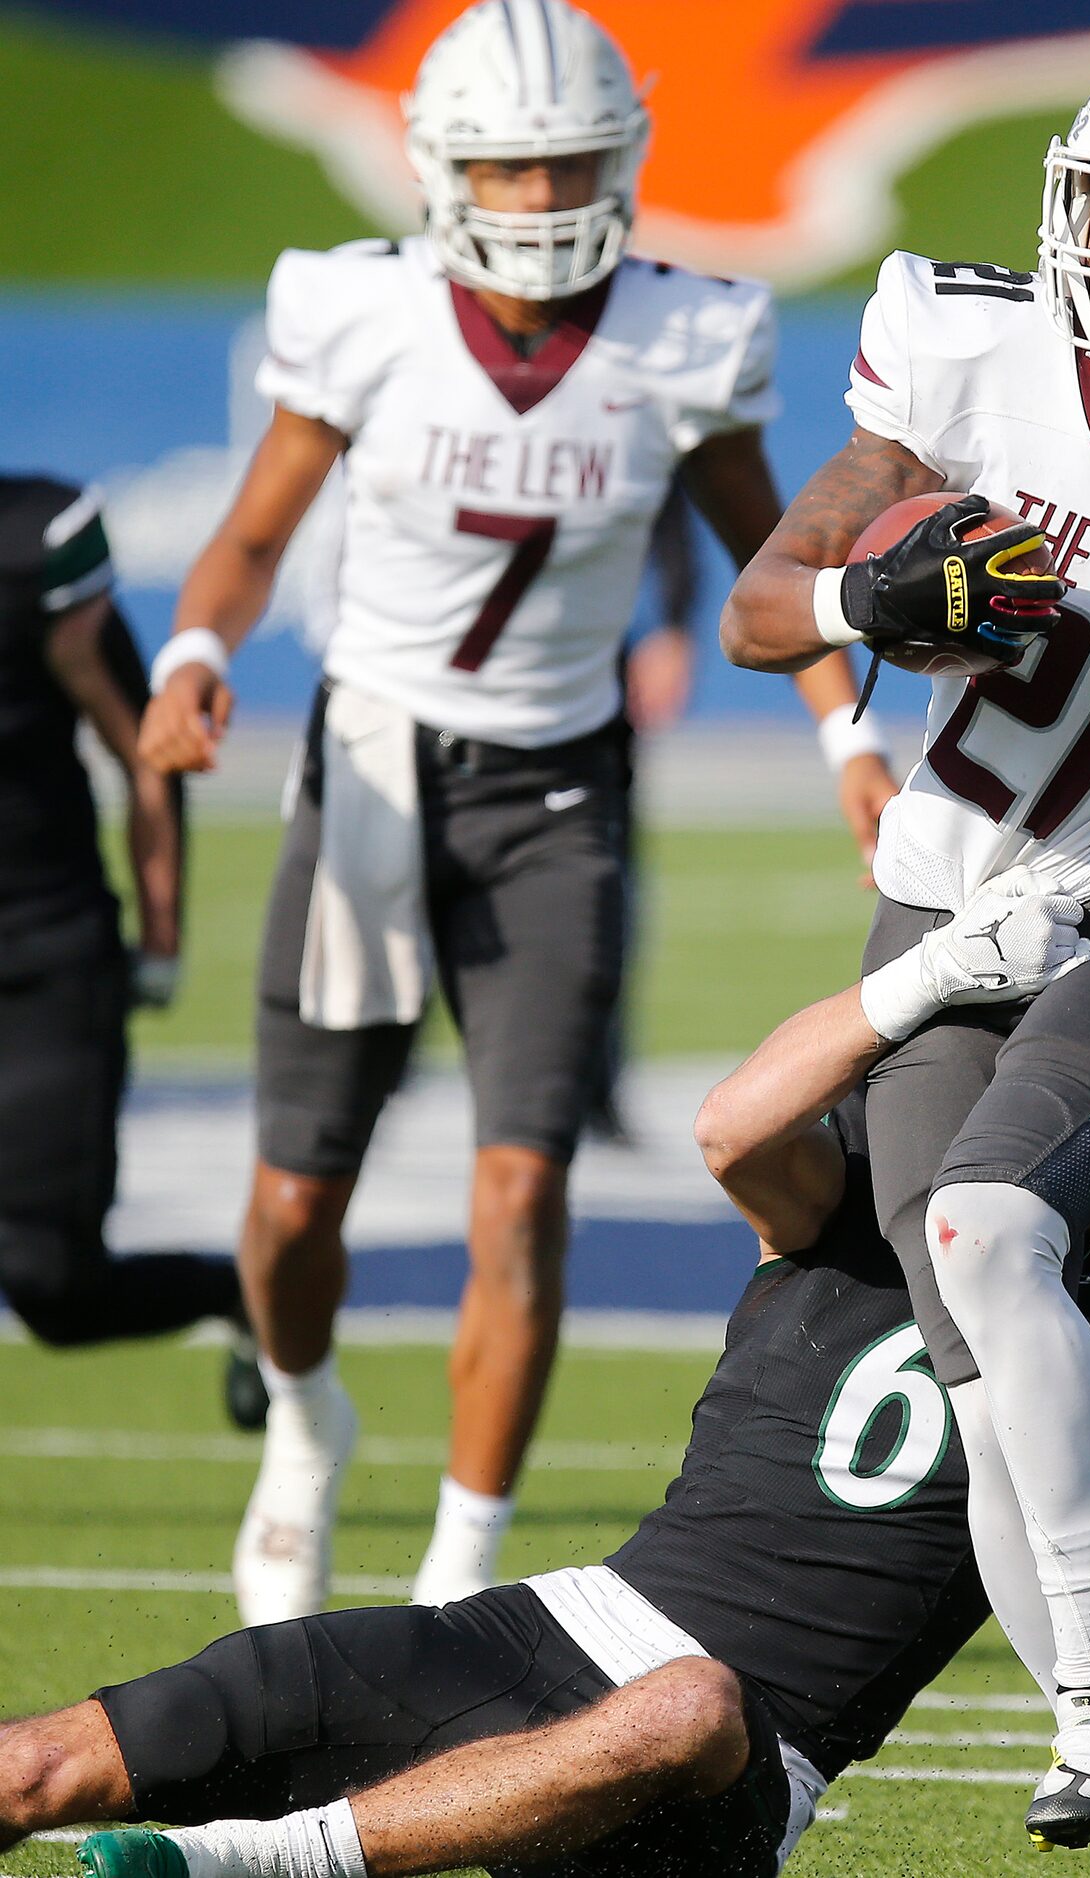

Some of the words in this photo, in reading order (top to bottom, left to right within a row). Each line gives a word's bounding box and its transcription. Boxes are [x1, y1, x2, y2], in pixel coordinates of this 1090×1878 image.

[931, 262, 1034, 302] 21
[420, 424, 501, 493] THE
[516, 434, 614, 498] LEW
[450, 507, 556, 672] 7
[947, 561, 965, 629] BATTLE
[811, 1318, 952, 1513] 6
